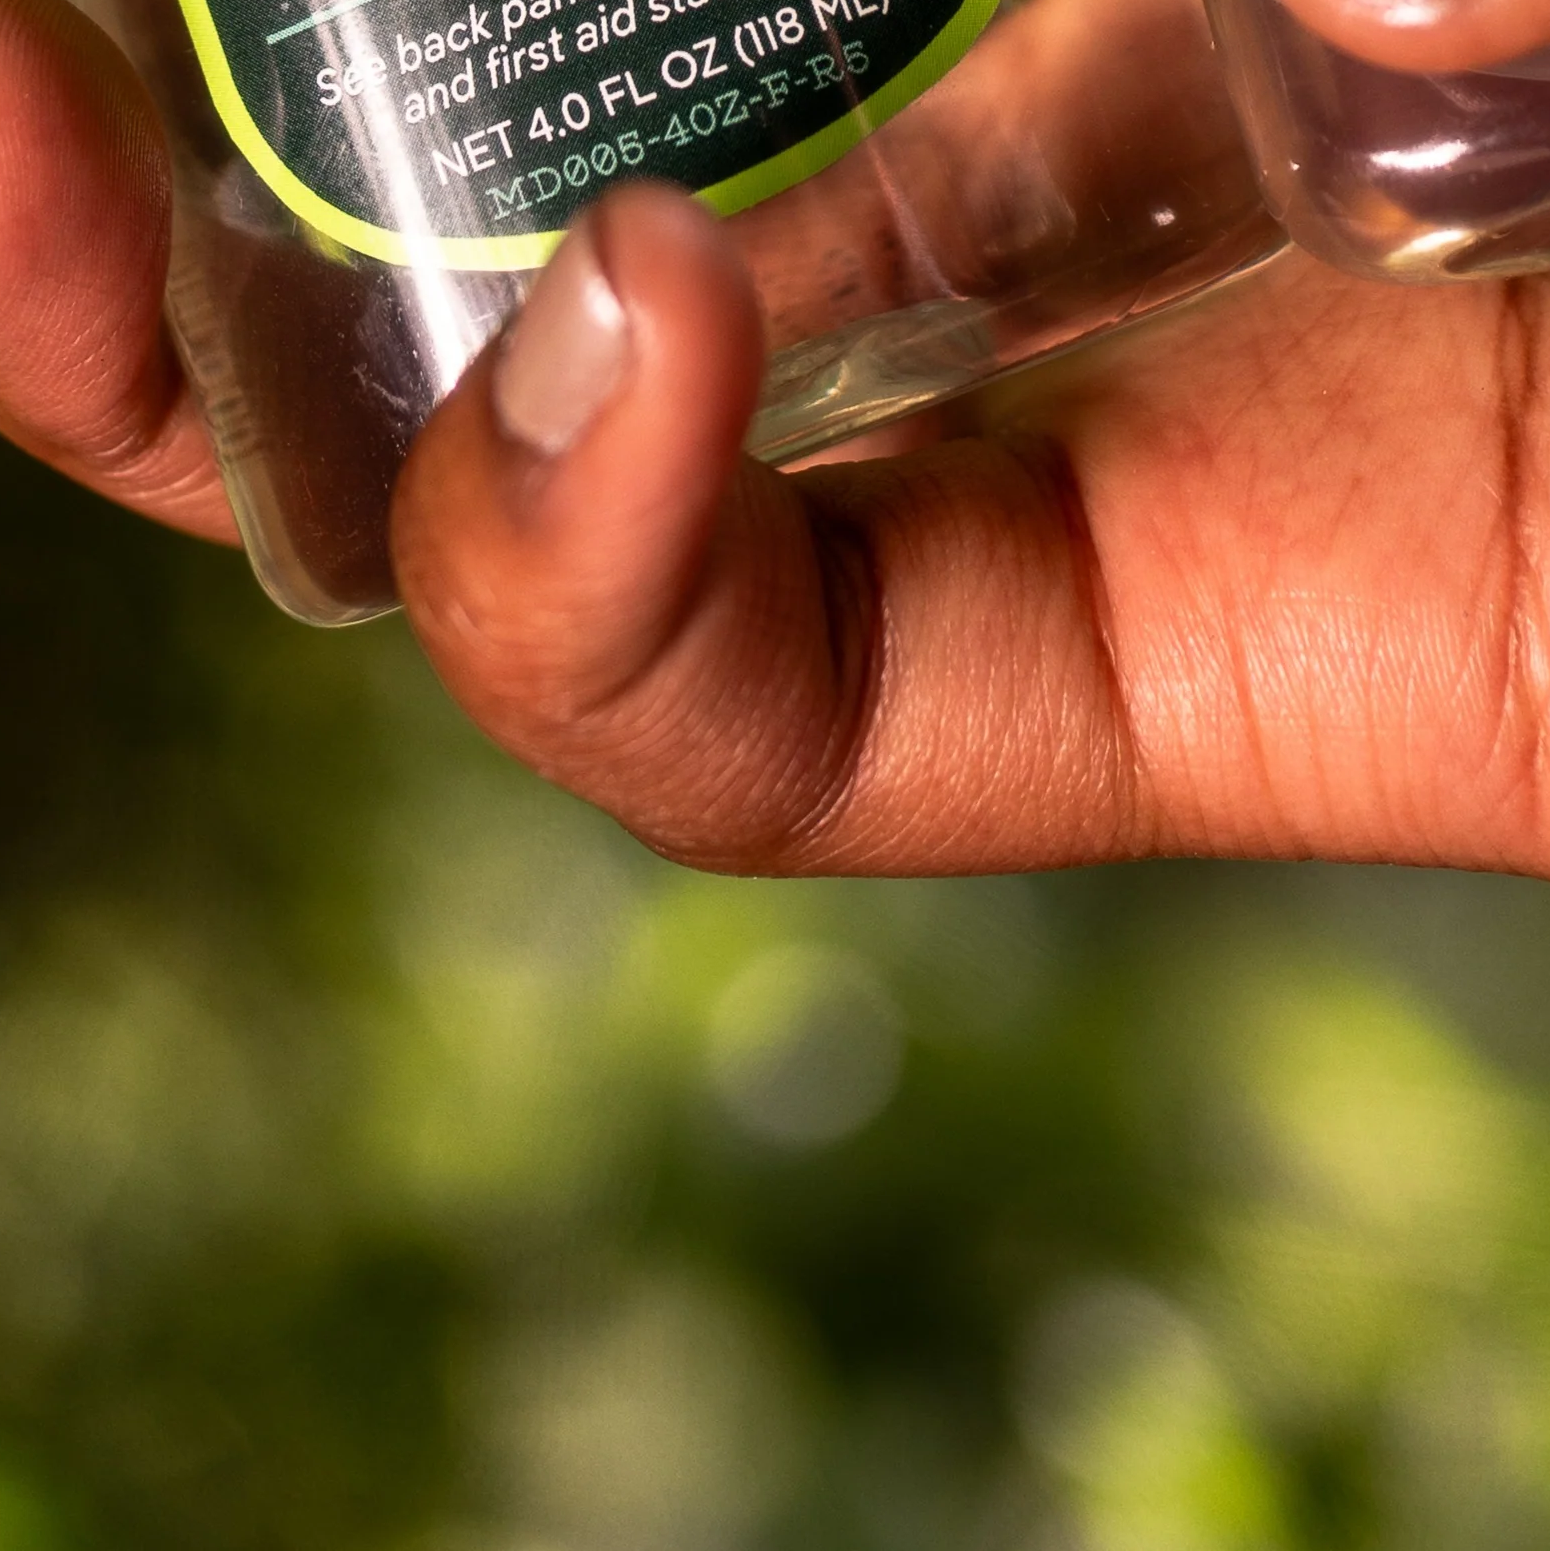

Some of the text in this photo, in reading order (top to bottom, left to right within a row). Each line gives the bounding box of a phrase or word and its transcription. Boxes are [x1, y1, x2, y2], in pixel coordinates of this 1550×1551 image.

[315, 56, 388, 107] See
[397, 3, 493, 75] back
[403, 57, 477, 124] and
[486, 27, 566, 89] first
[430, 119, 514, 186] NET
[528, 92, 591, 144] 4.0
[599, 70, 658, 117] FL
[660, 36, 729, 89] OZ
[733, 6, 805, 68] (118
